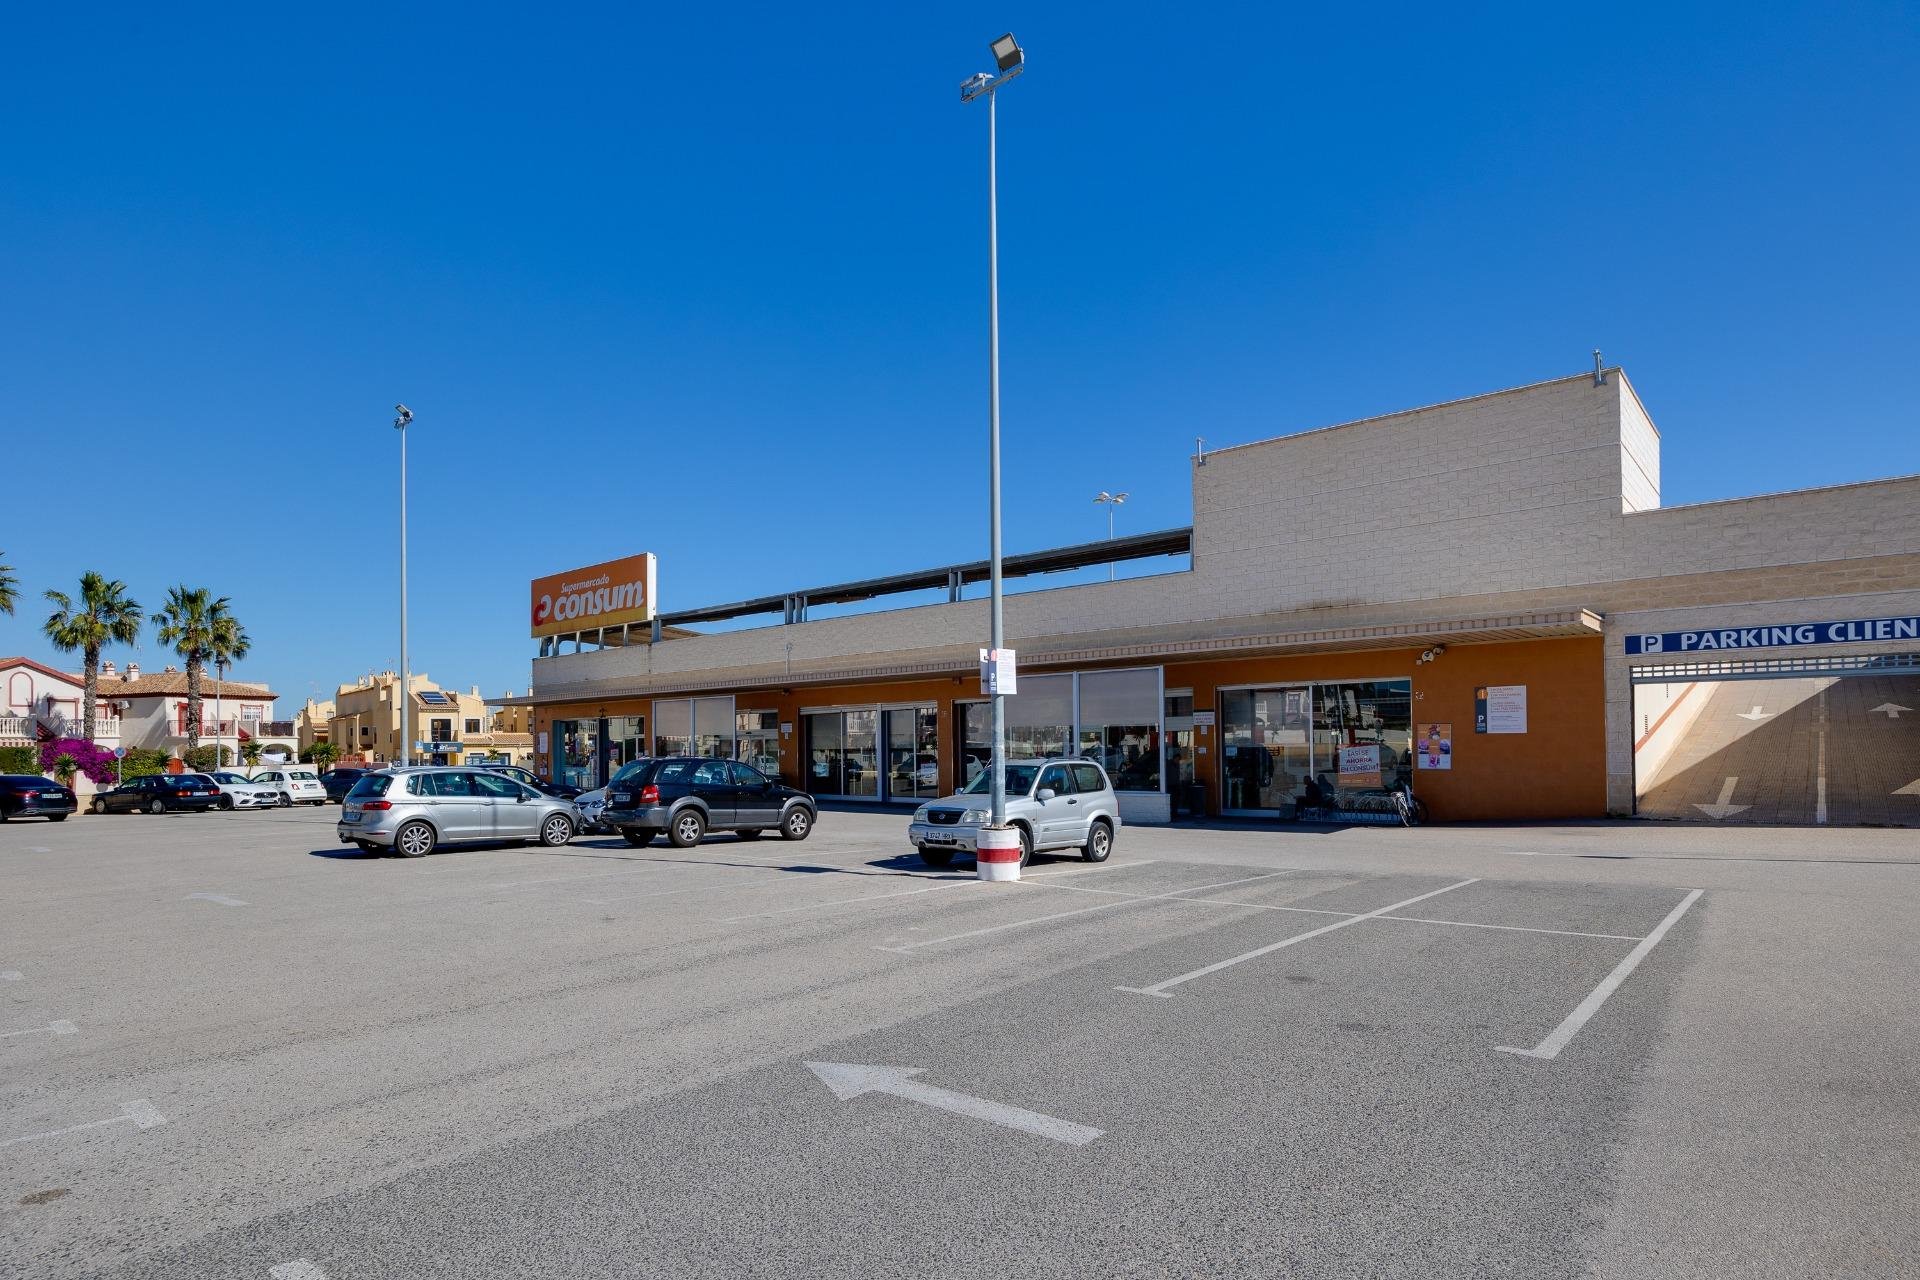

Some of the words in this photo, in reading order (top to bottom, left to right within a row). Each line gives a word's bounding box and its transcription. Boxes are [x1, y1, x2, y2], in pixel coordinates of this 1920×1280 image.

[561, 573, 609, 594] Supermercado
[554, 581, 644, 621] consum
[1645, 635, 1658, 651] P
[1681, 625, 1815, 650] PARKING
[1828, 619, 1917, 641] CLIEN
